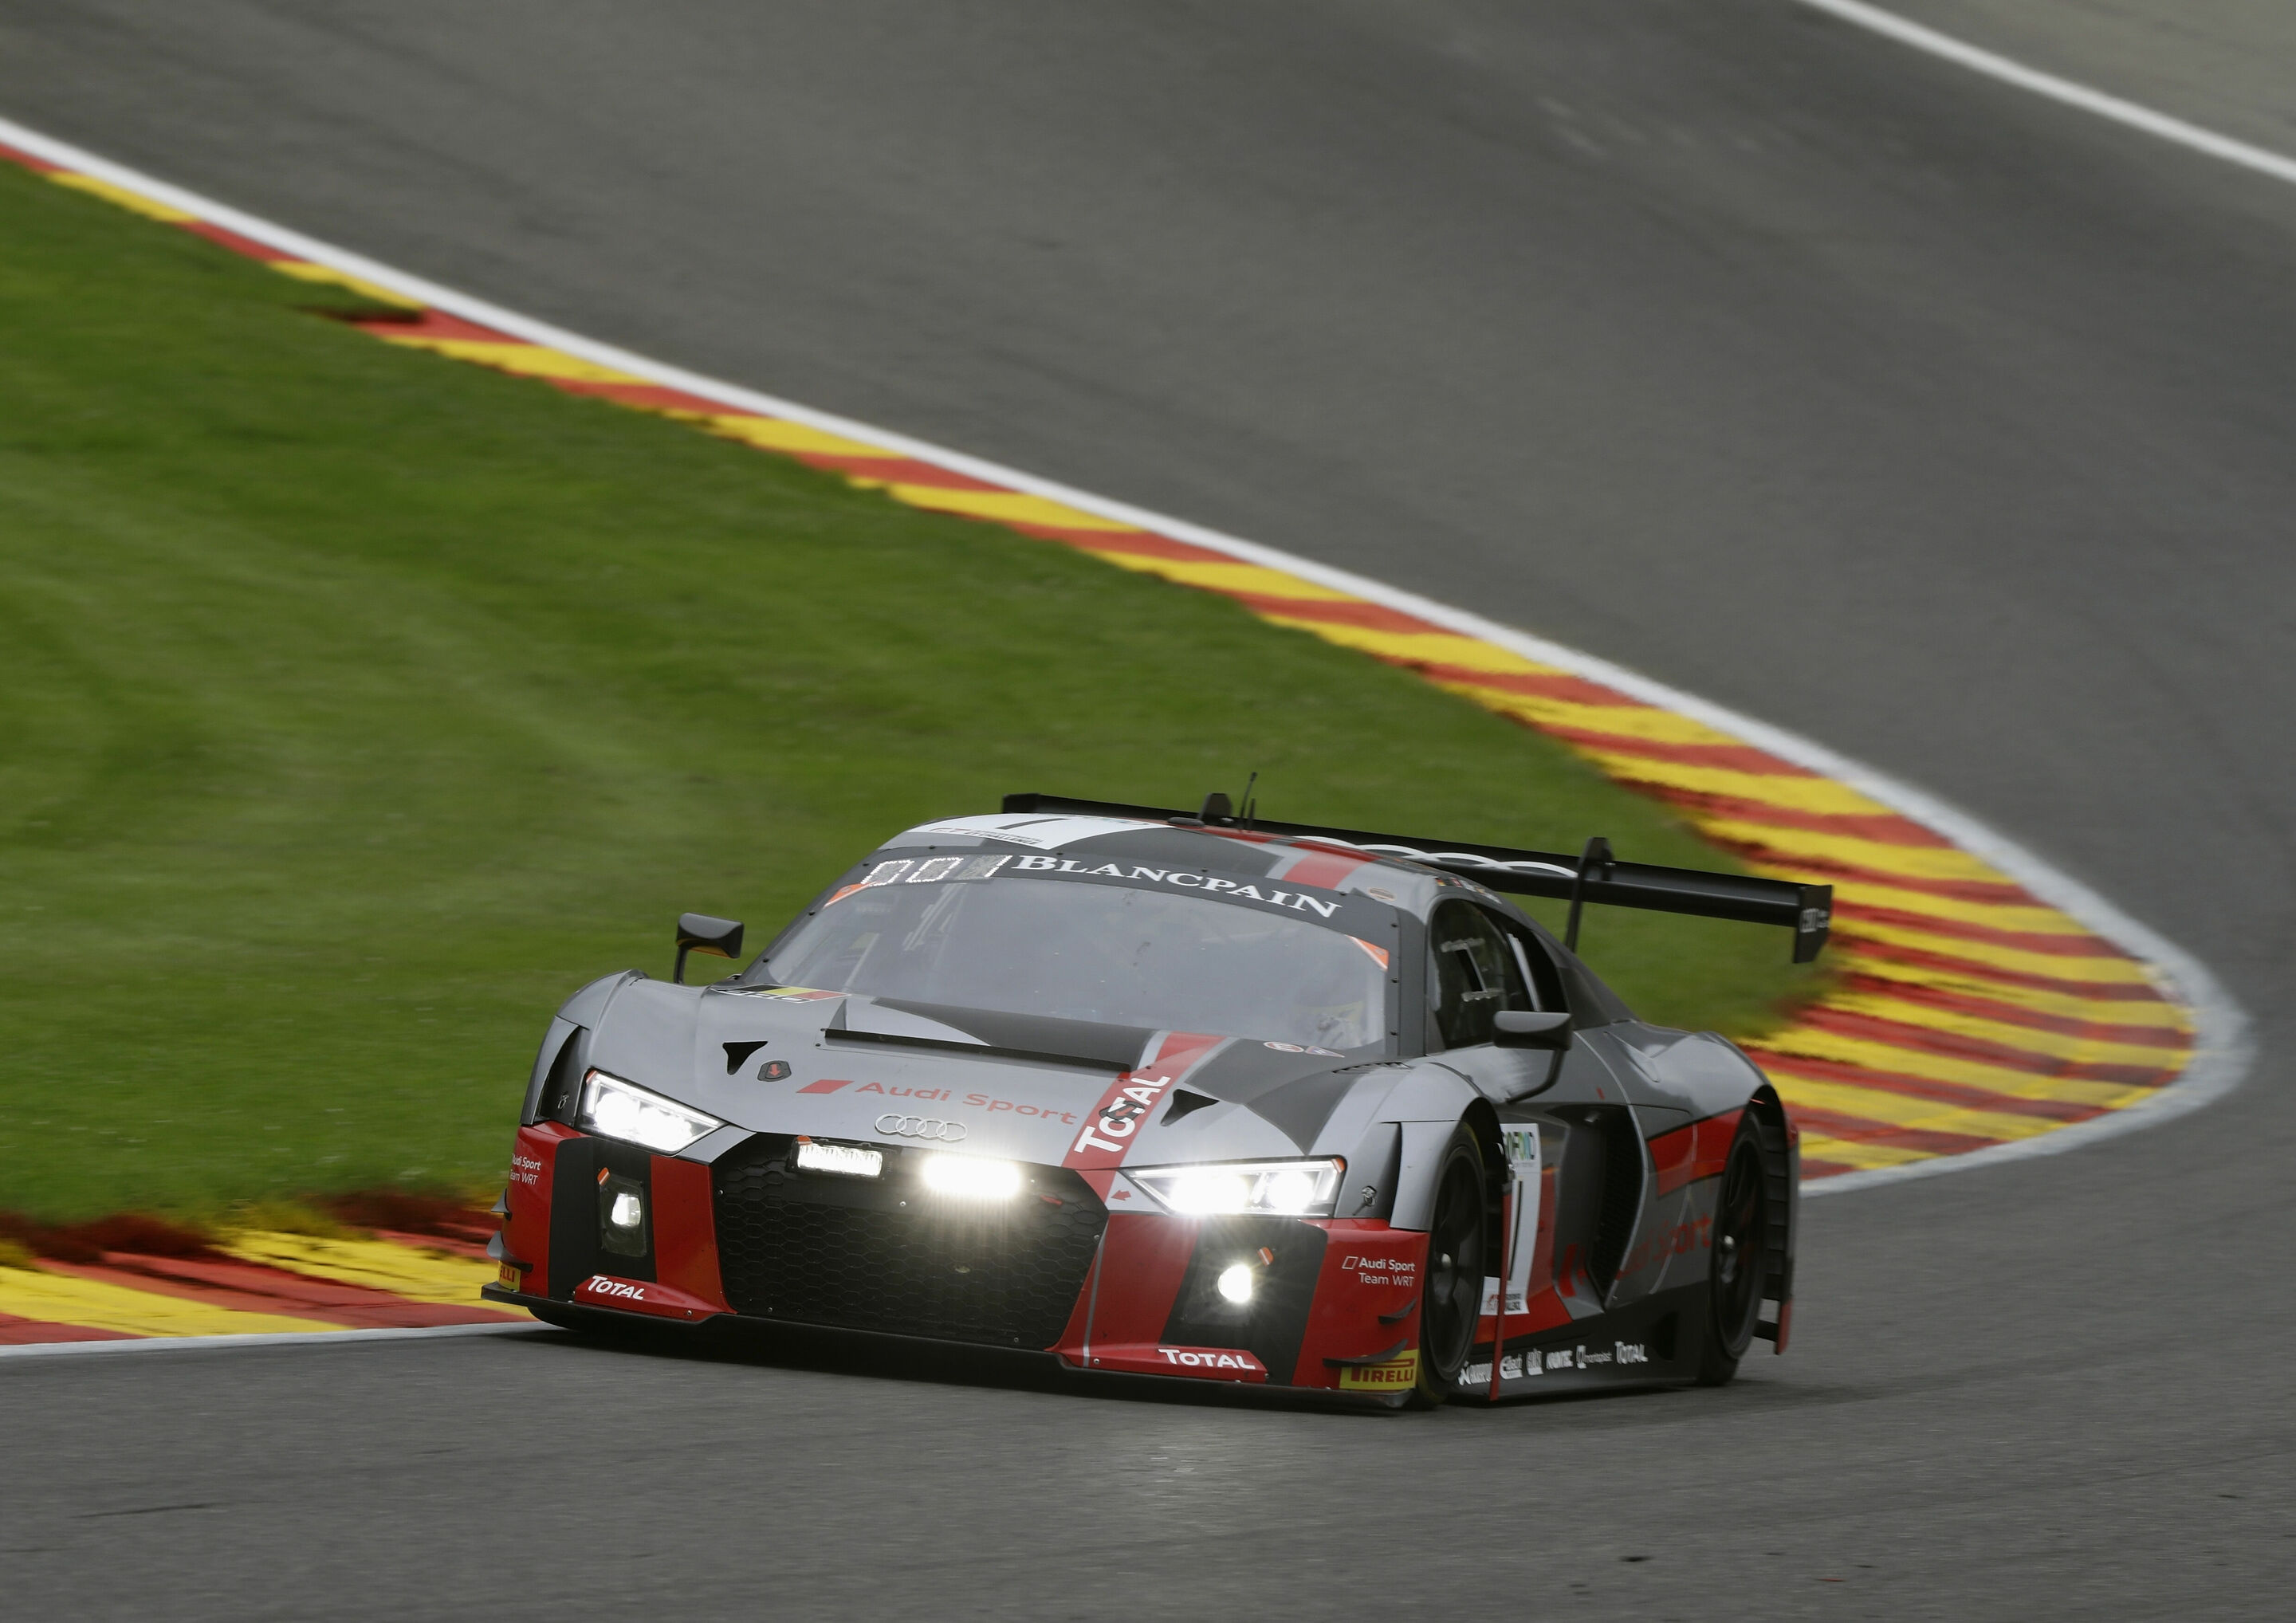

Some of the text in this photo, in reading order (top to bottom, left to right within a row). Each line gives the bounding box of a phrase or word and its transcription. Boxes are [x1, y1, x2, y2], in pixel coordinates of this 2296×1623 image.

[1011, 855, 1343, 918] BLANCPAIN
[855, 1082, 1078, 1126] Audi Sport
[521, 1157, 541, 1170] Sport
[521, 1173, 538, 1185] WRT
[1358, 1257, 1415, 1272] Audi Sport
[587, 1275, 645, 1300] TOTAL
[1358, 1272, 1414, 1287] Team WRT
[1158, 1349, 1256, 1370] TOTAL
[1350, 1358, 1415, 1383] PIRELLI
